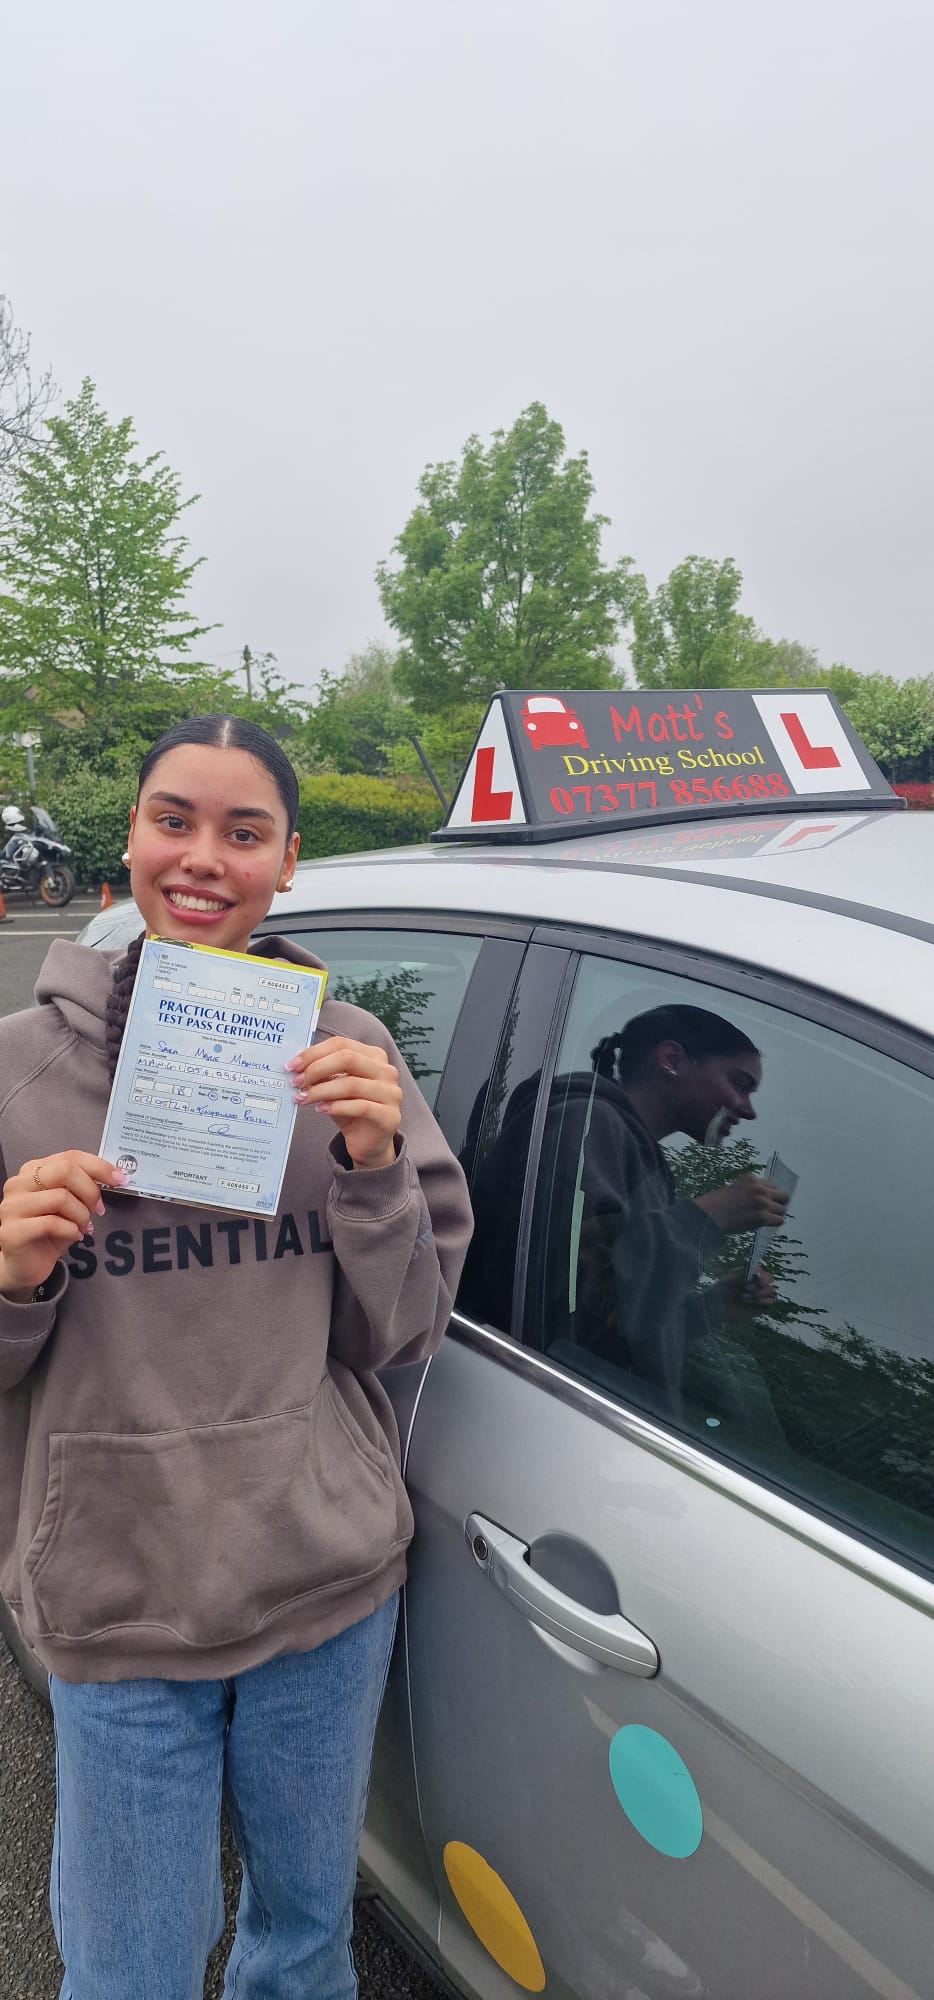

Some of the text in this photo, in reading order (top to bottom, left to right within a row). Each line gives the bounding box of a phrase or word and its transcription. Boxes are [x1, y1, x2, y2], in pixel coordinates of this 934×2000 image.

[609, 694, 735, 745] Matt's
[780, 713, 842, 769] L
[562, 746, 766, 776] Driving School
[471, 747, 513, 822] L
[549, 773, 790, 815] 07377 856688
[158, 1012, 284, 1044] TEST PASS CERTIFICATE
[159, 999, 286, 1033] PRACTICAL DRIVING
[117, 1159, 137, 1170] DVSA
[172, 1170, 208, 1181] IMPORTANT
